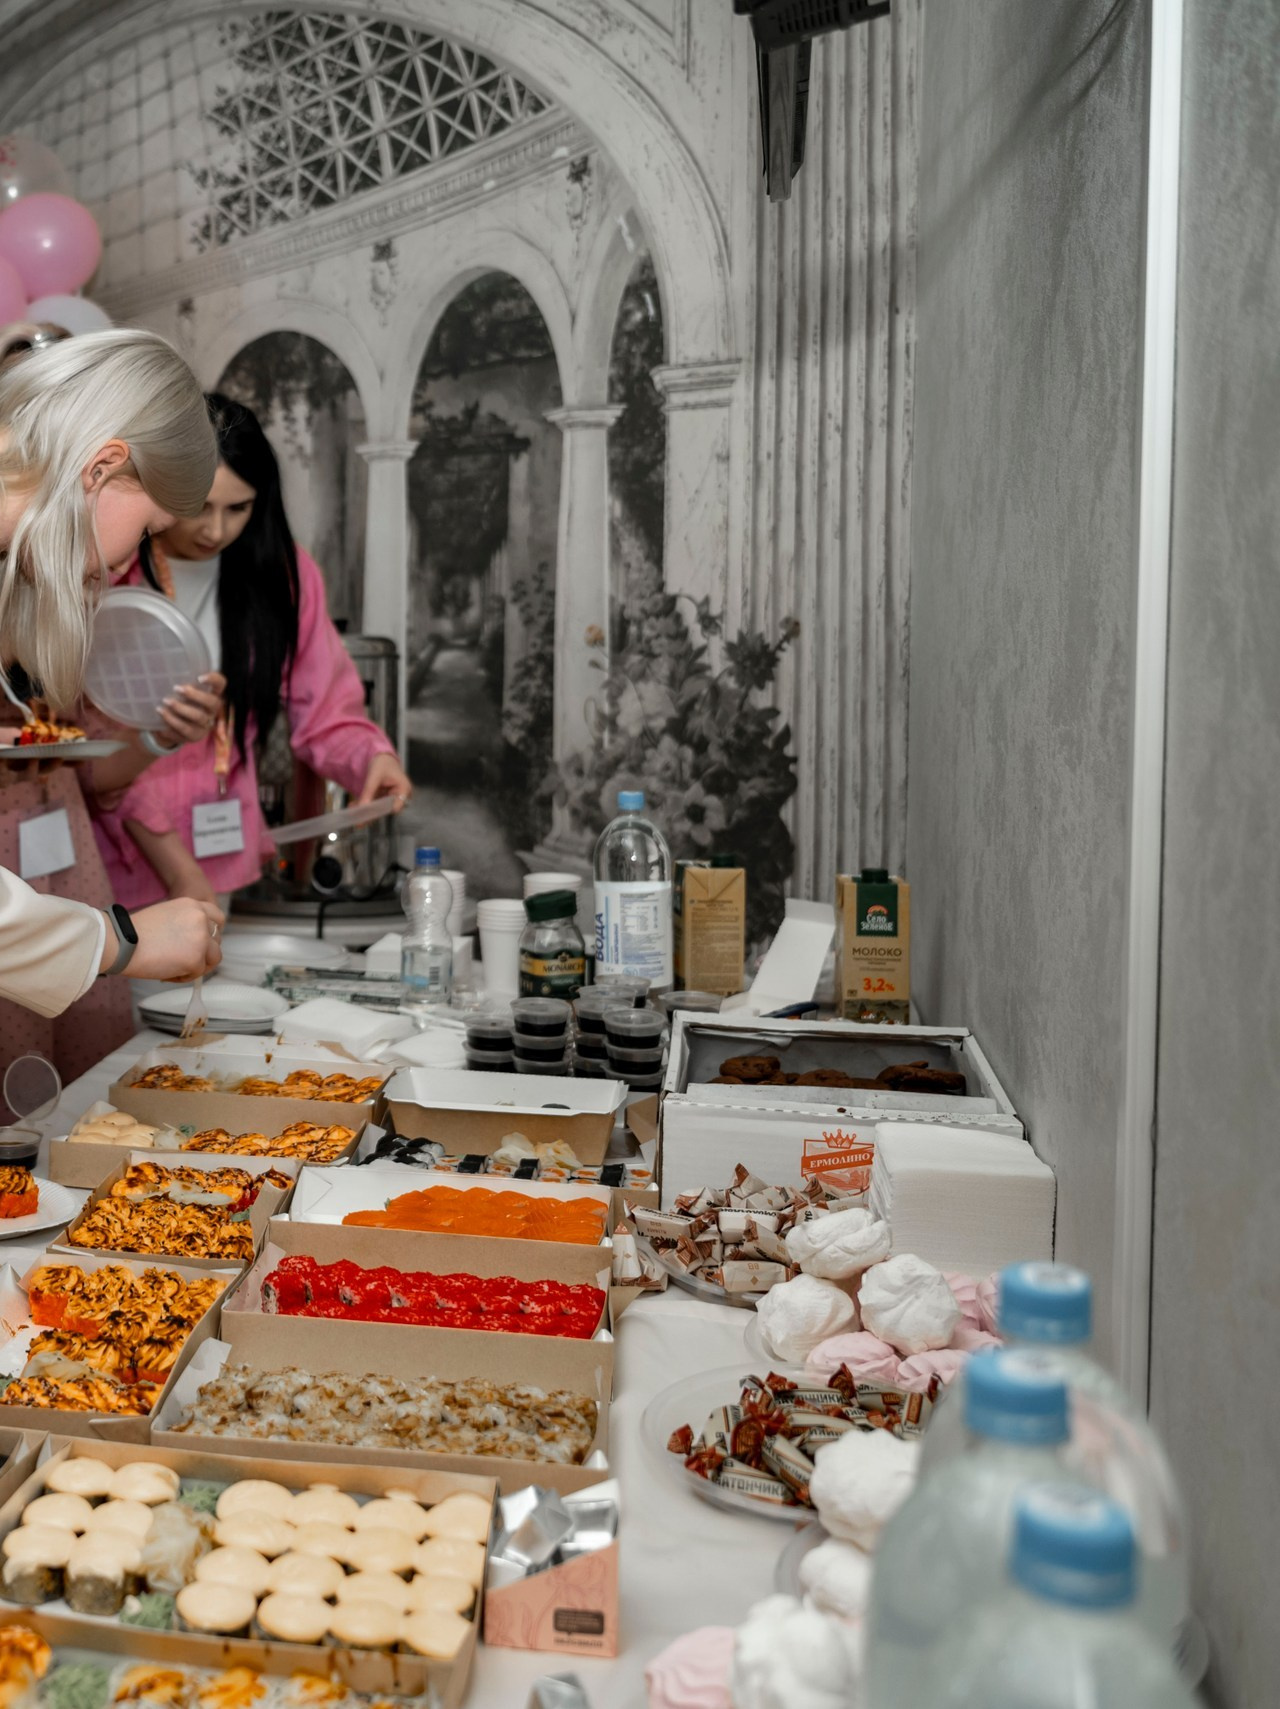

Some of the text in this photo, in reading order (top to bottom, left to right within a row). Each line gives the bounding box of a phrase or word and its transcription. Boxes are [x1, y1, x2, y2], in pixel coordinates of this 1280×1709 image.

[866, 913, 887, 924] Село
[595, 913, 605, 962] ВОДА
[852, 947, 902, 957] МОЛОКО
[863, 977, 895, 992] 3,2%
[810, 1152, 871, 1169] ЕРМОЛИНО
